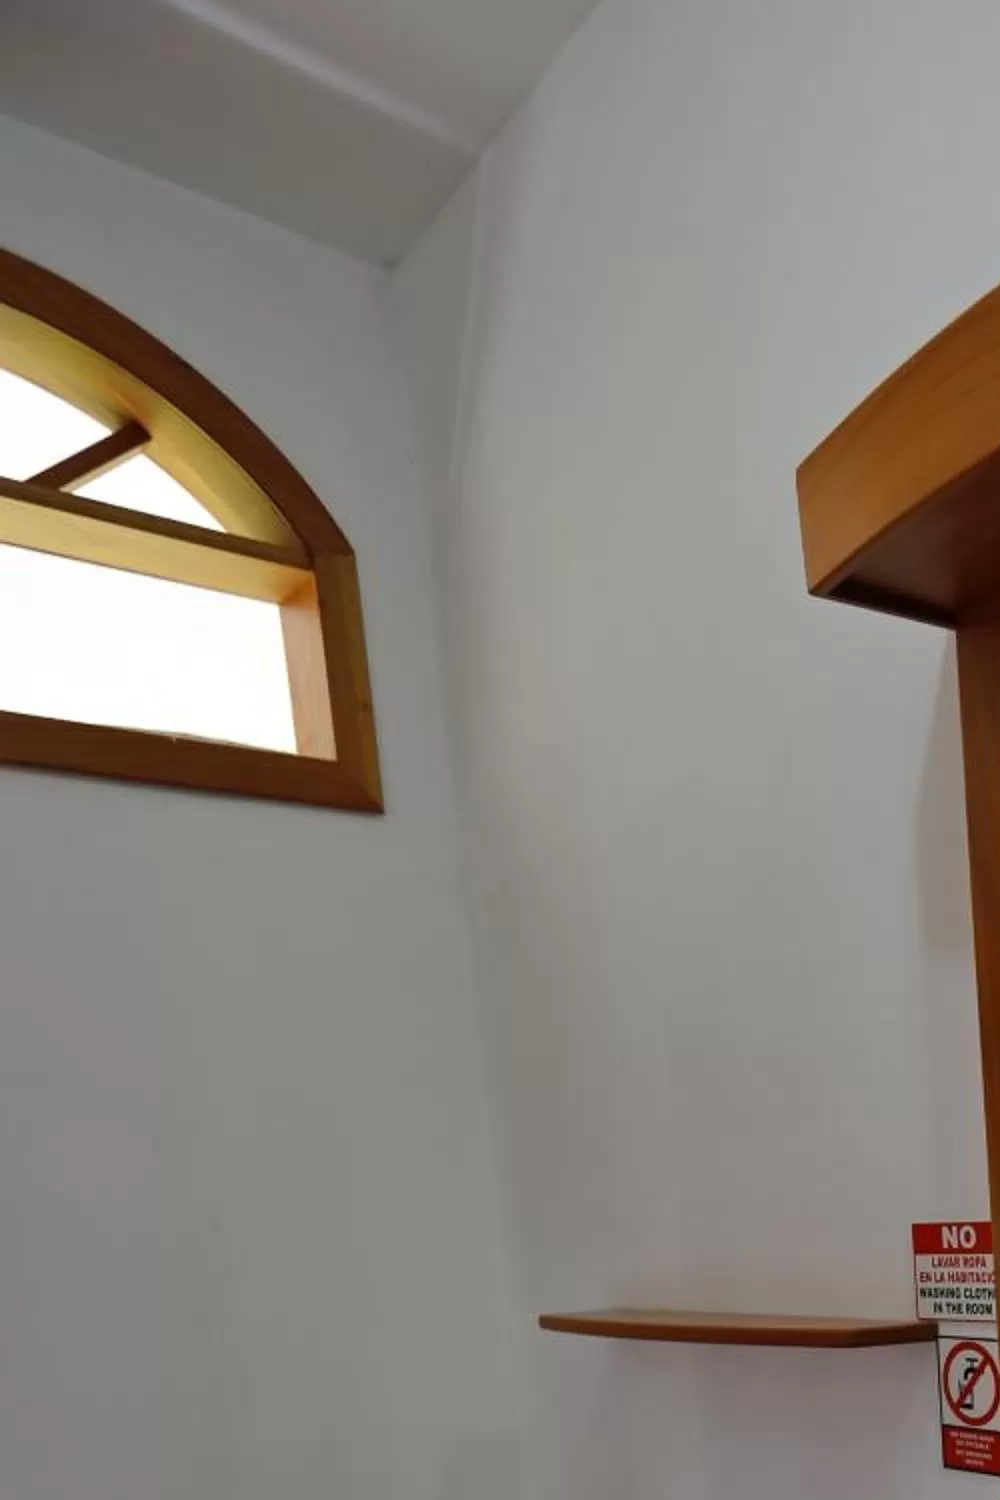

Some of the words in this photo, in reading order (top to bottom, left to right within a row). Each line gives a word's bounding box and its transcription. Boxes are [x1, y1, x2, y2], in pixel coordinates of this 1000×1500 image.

[941, 1224, 977, 1249] NO
[919, 1271, 932, 1283] EN
[933, 1271, 945, 1283] LA
[933, 1302, 943, 1313] IN
[945, 1302, 964, 1314] THE
[965, 1303, 993, 1315] ROOM
